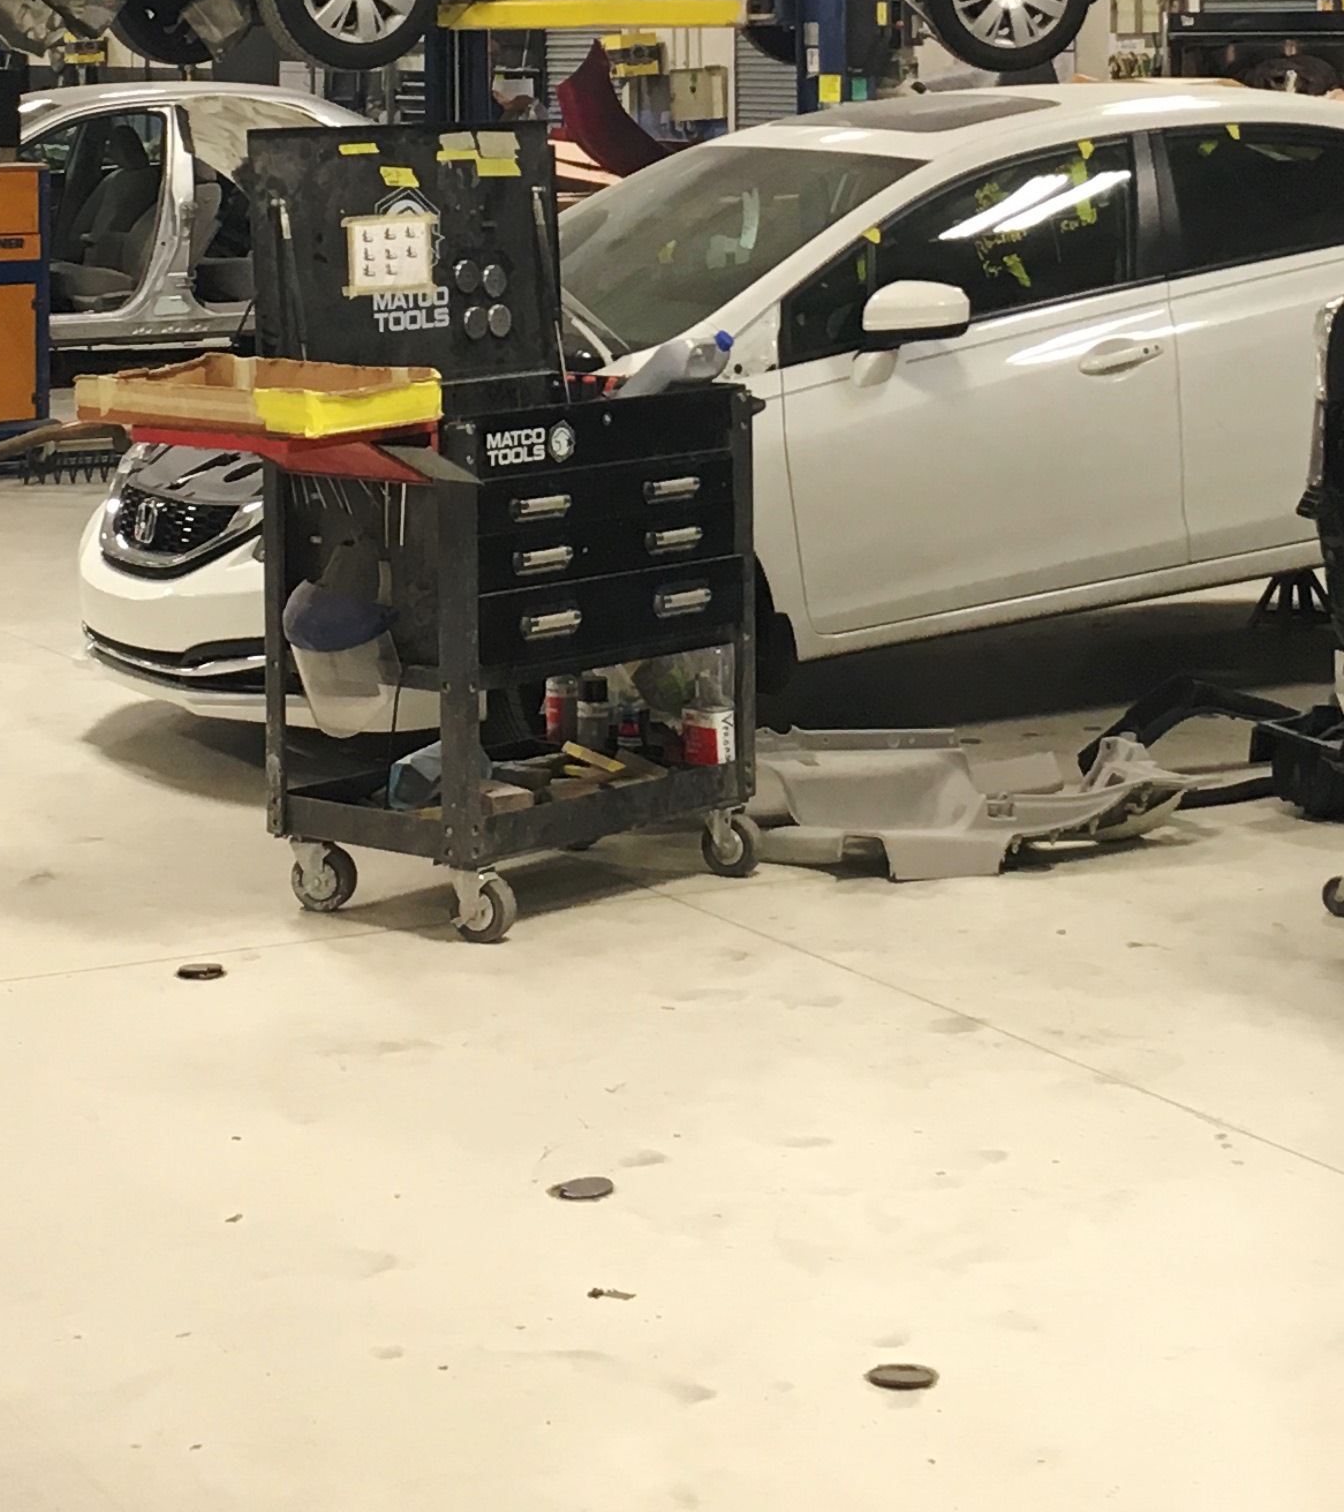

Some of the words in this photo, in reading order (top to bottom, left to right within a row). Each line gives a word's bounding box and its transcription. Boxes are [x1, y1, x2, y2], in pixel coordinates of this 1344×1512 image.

[373, 307, 450, 333] TOOLS
[486, 427, 546, 450] MATCO
[486, 444, 546, 467] TOOLS
